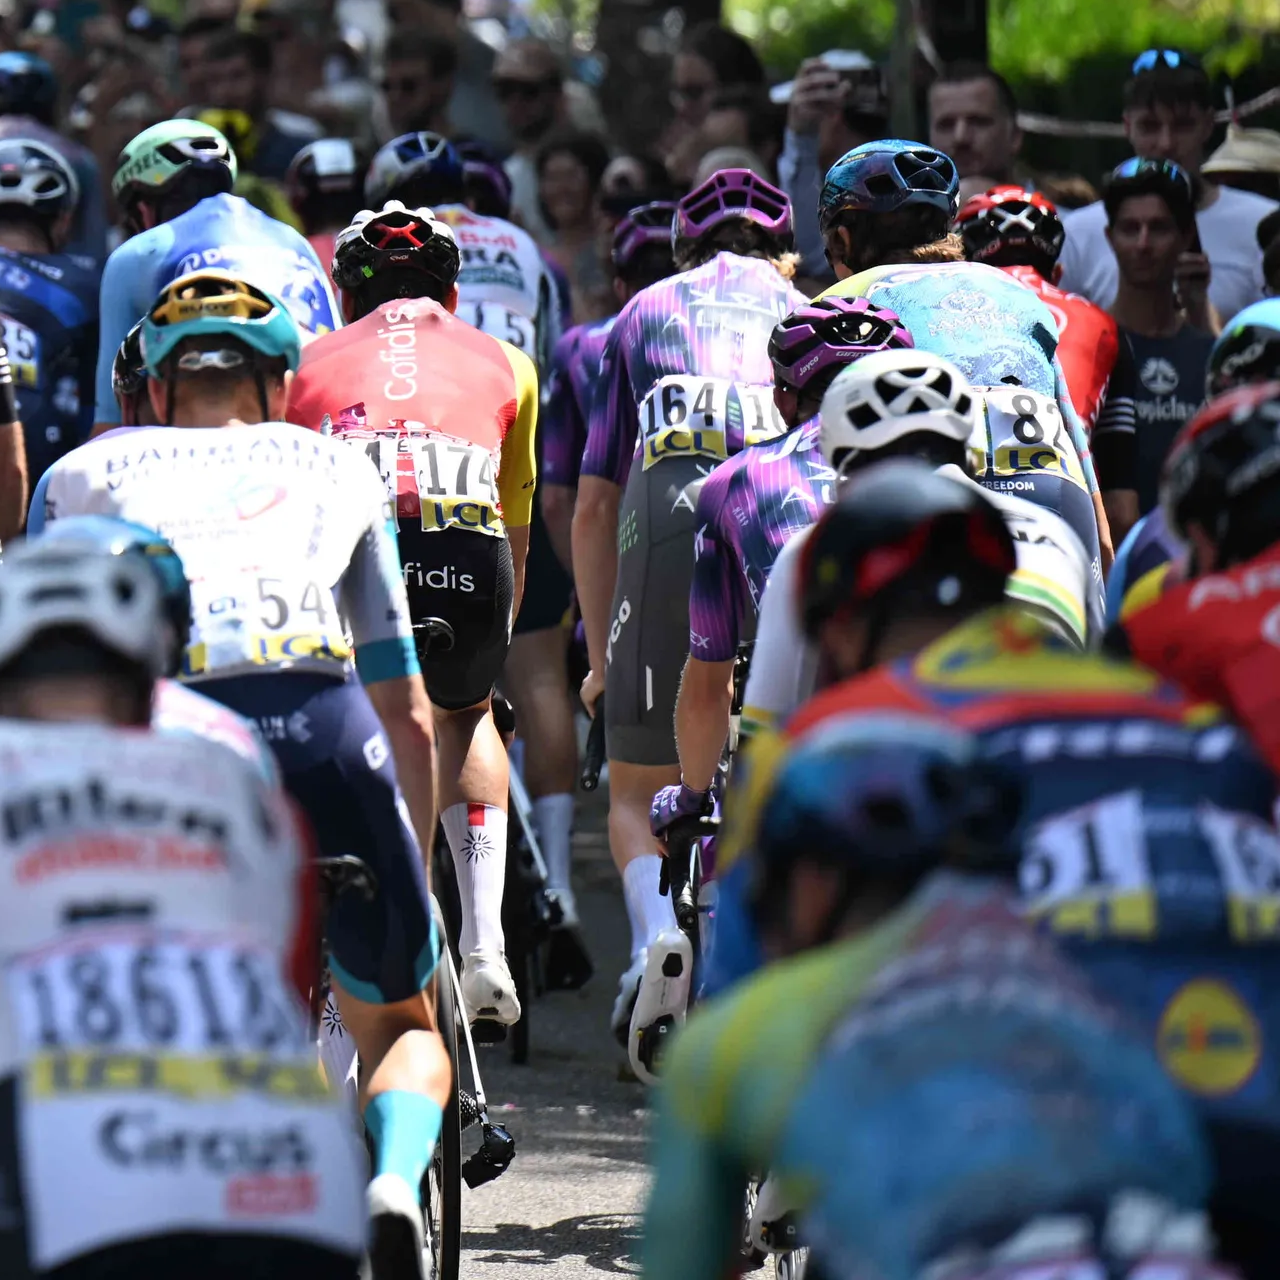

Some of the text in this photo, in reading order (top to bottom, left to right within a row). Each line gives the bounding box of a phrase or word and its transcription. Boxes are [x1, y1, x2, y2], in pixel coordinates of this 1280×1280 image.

[377, 303, 418, 401] Cofidis
[643, 382, 717, 435] 164
[649, 431, 717, 458] LCL
[433, 501, 499, 533] LCL
[401, 562, 476, 593] fidis
[256, 577, 328, 631] 54
